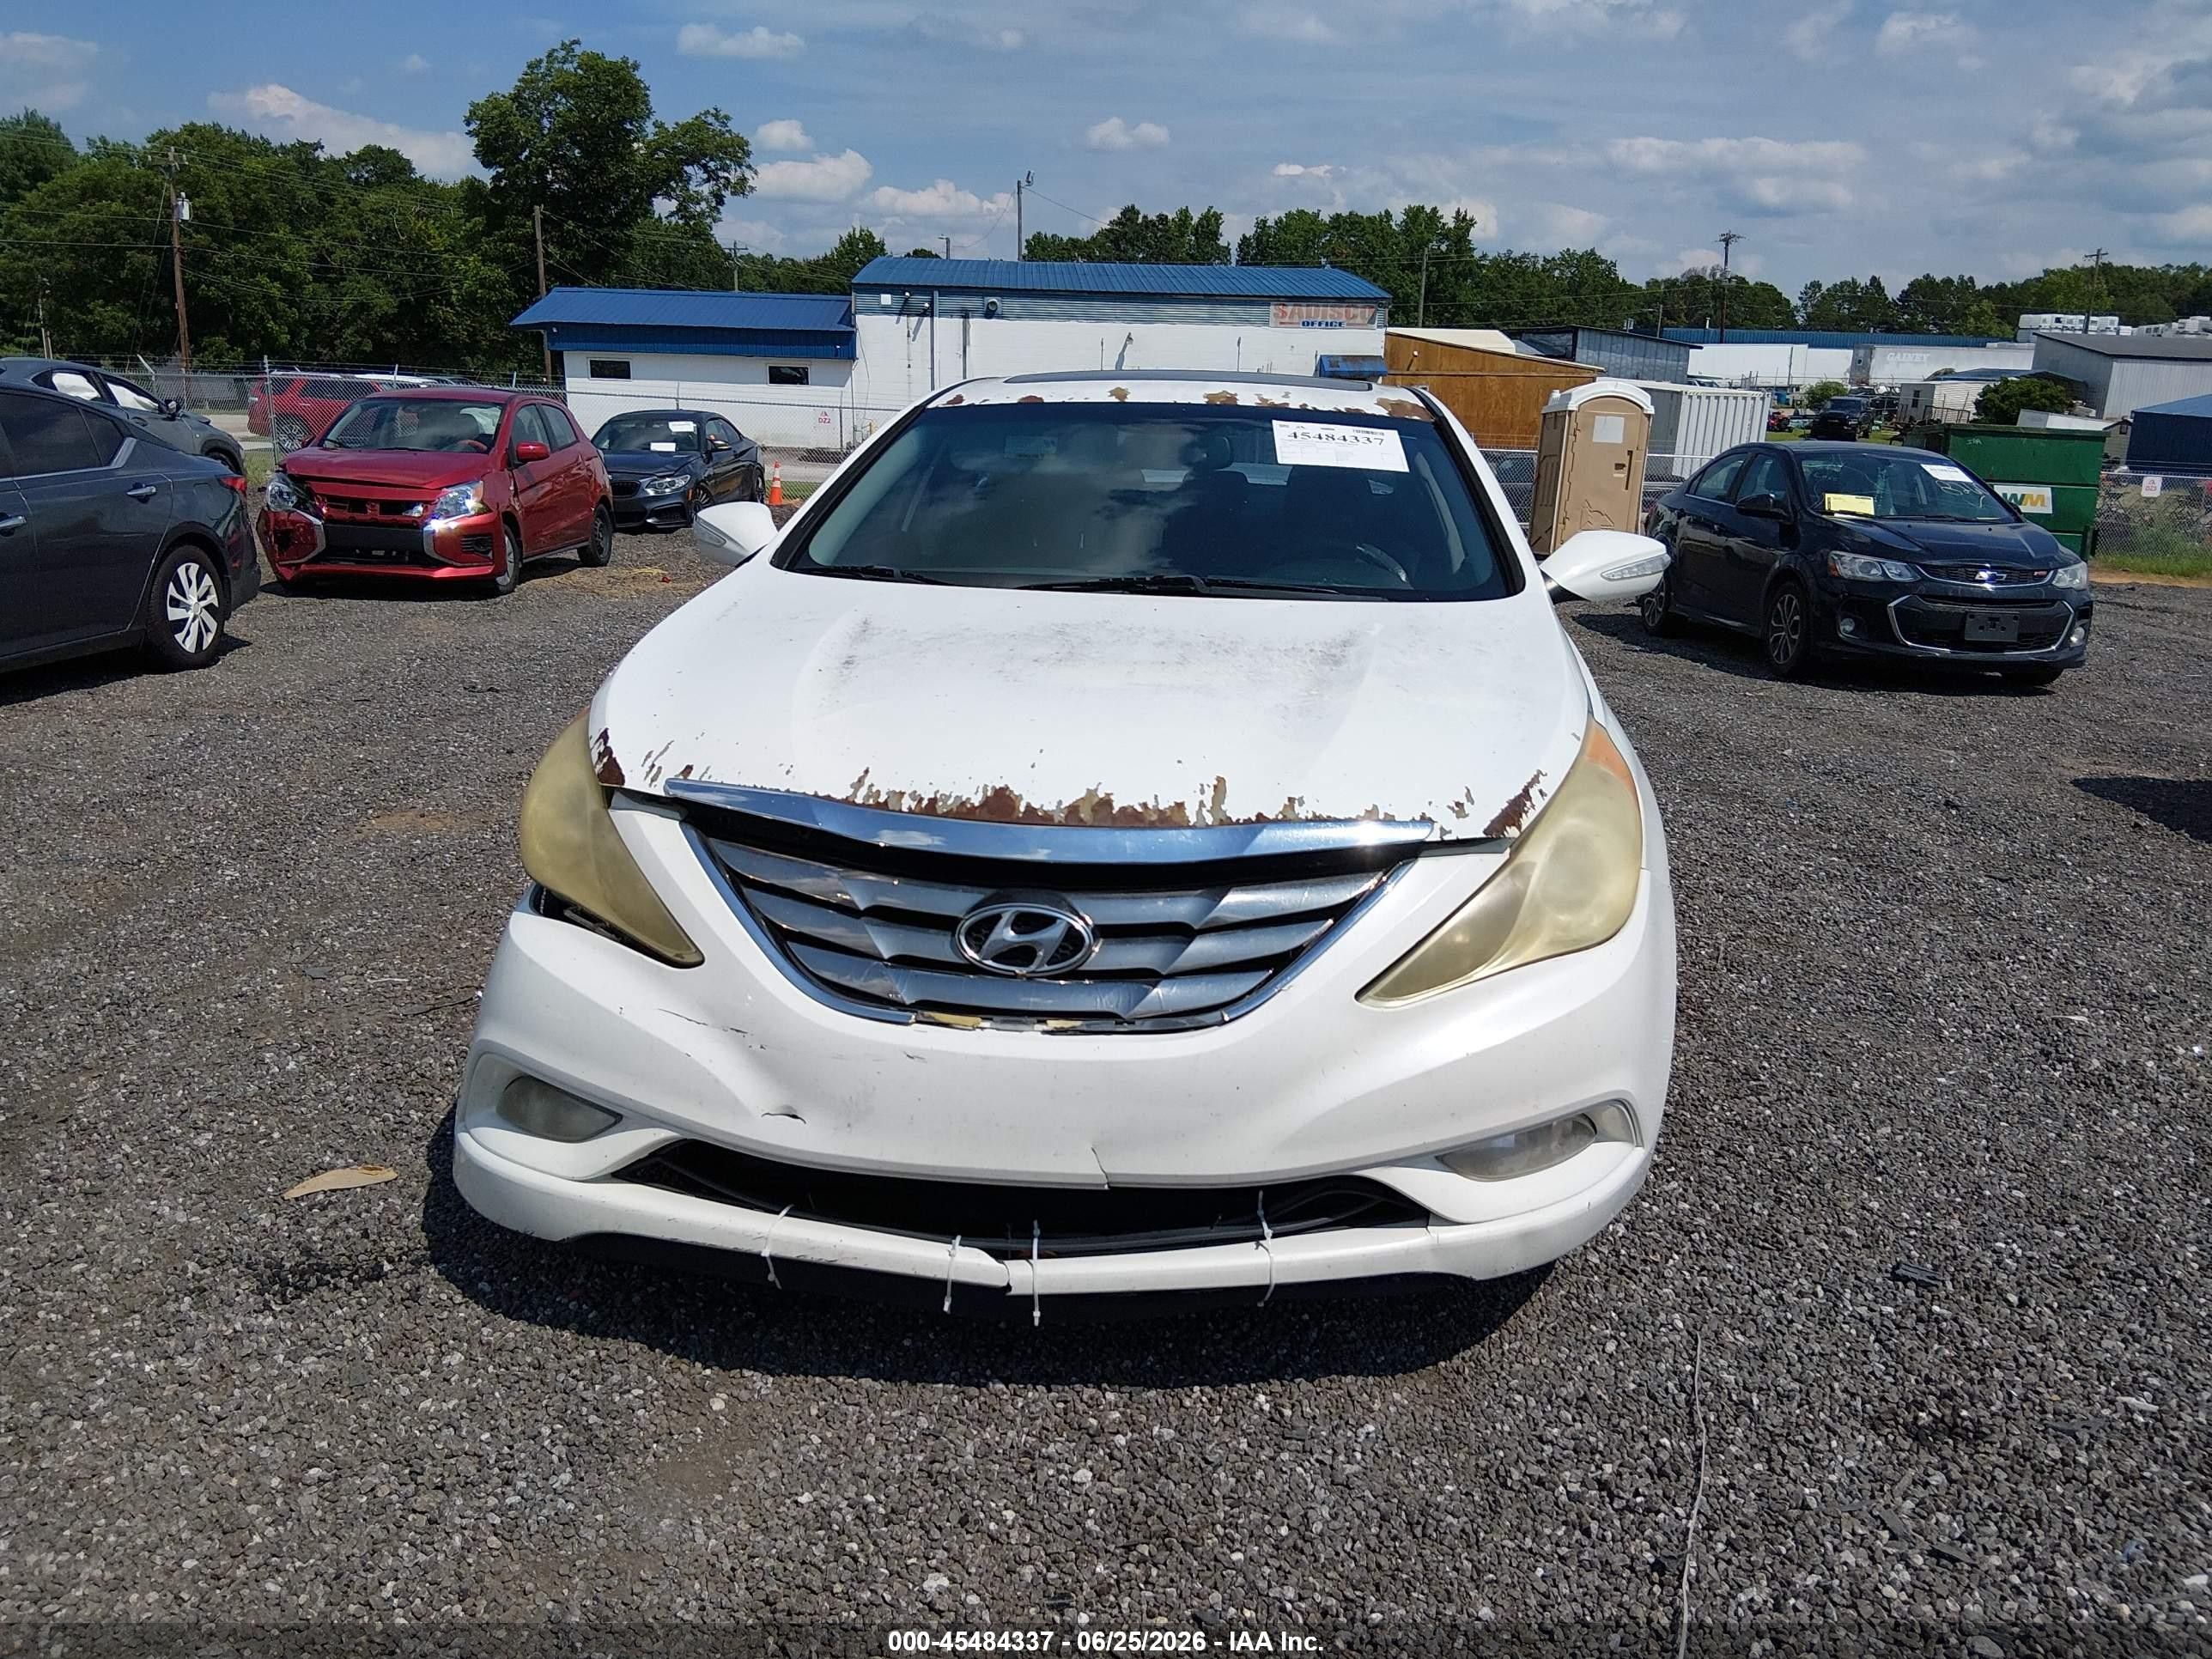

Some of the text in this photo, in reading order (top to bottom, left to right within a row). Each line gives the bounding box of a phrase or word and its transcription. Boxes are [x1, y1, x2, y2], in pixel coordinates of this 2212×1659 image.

[1273, 303, 1375, 320] SADISCO
[1287, 431, 1384, 446] 45484337
[2002, 492, 2047, 507] WM
